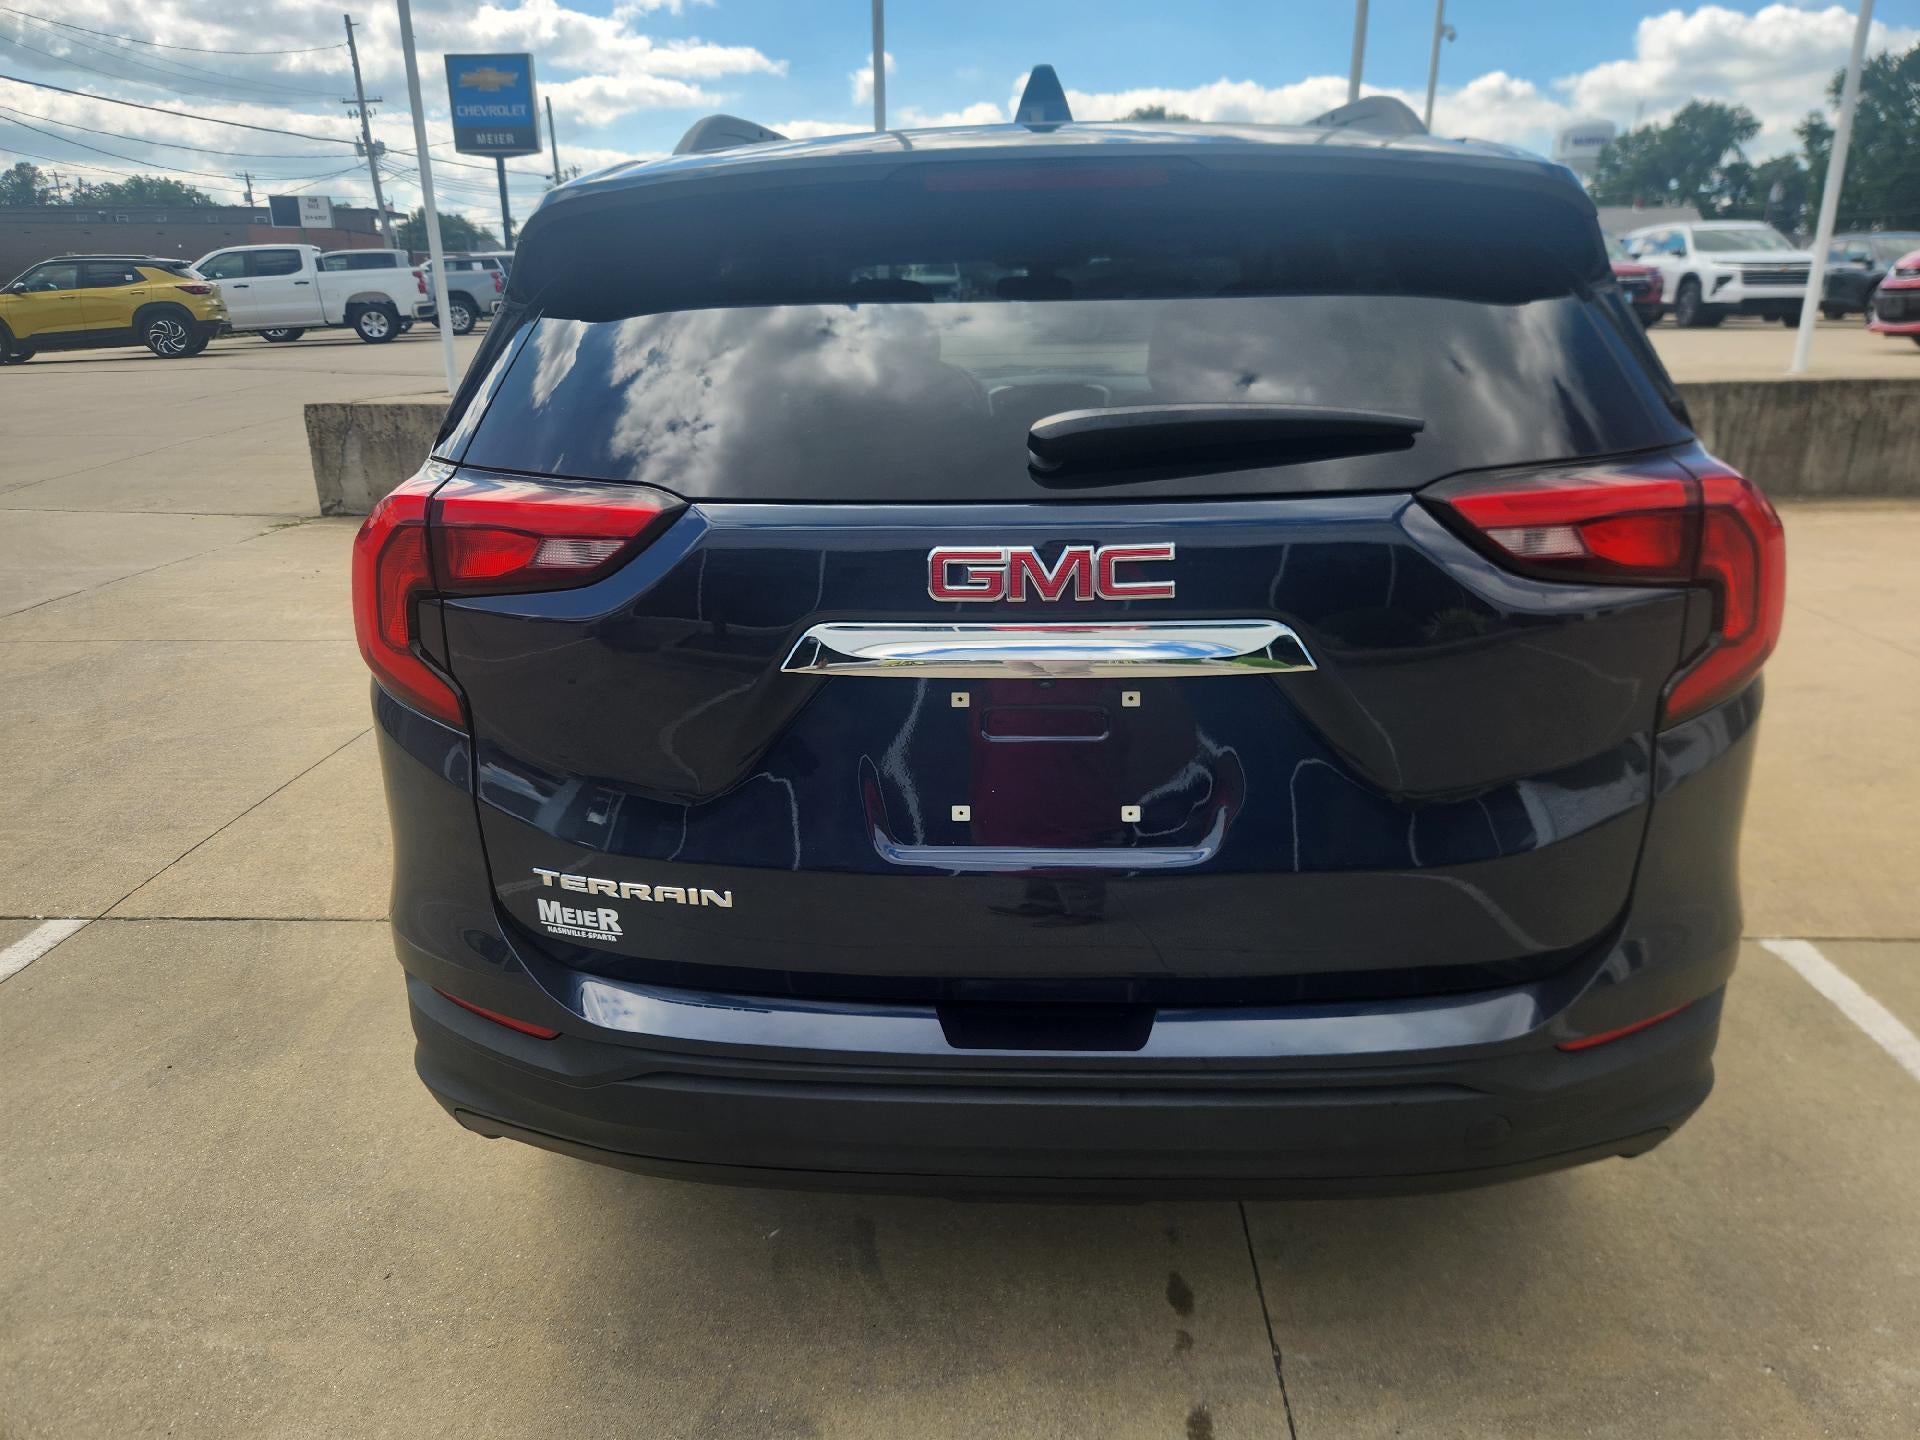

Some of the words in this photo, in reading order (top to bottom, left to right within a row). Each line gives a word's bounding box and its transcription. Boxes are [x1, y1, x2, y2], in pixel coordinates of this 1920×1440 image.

[456, 104, 527, 117] CHEVROLET
[476, 133, 515, 145] MEIER
[927, 542, 1176, 602] GMC
[532, 867, 733, 908] TERRAIN
[537, 898, 623, 932] MEIER
